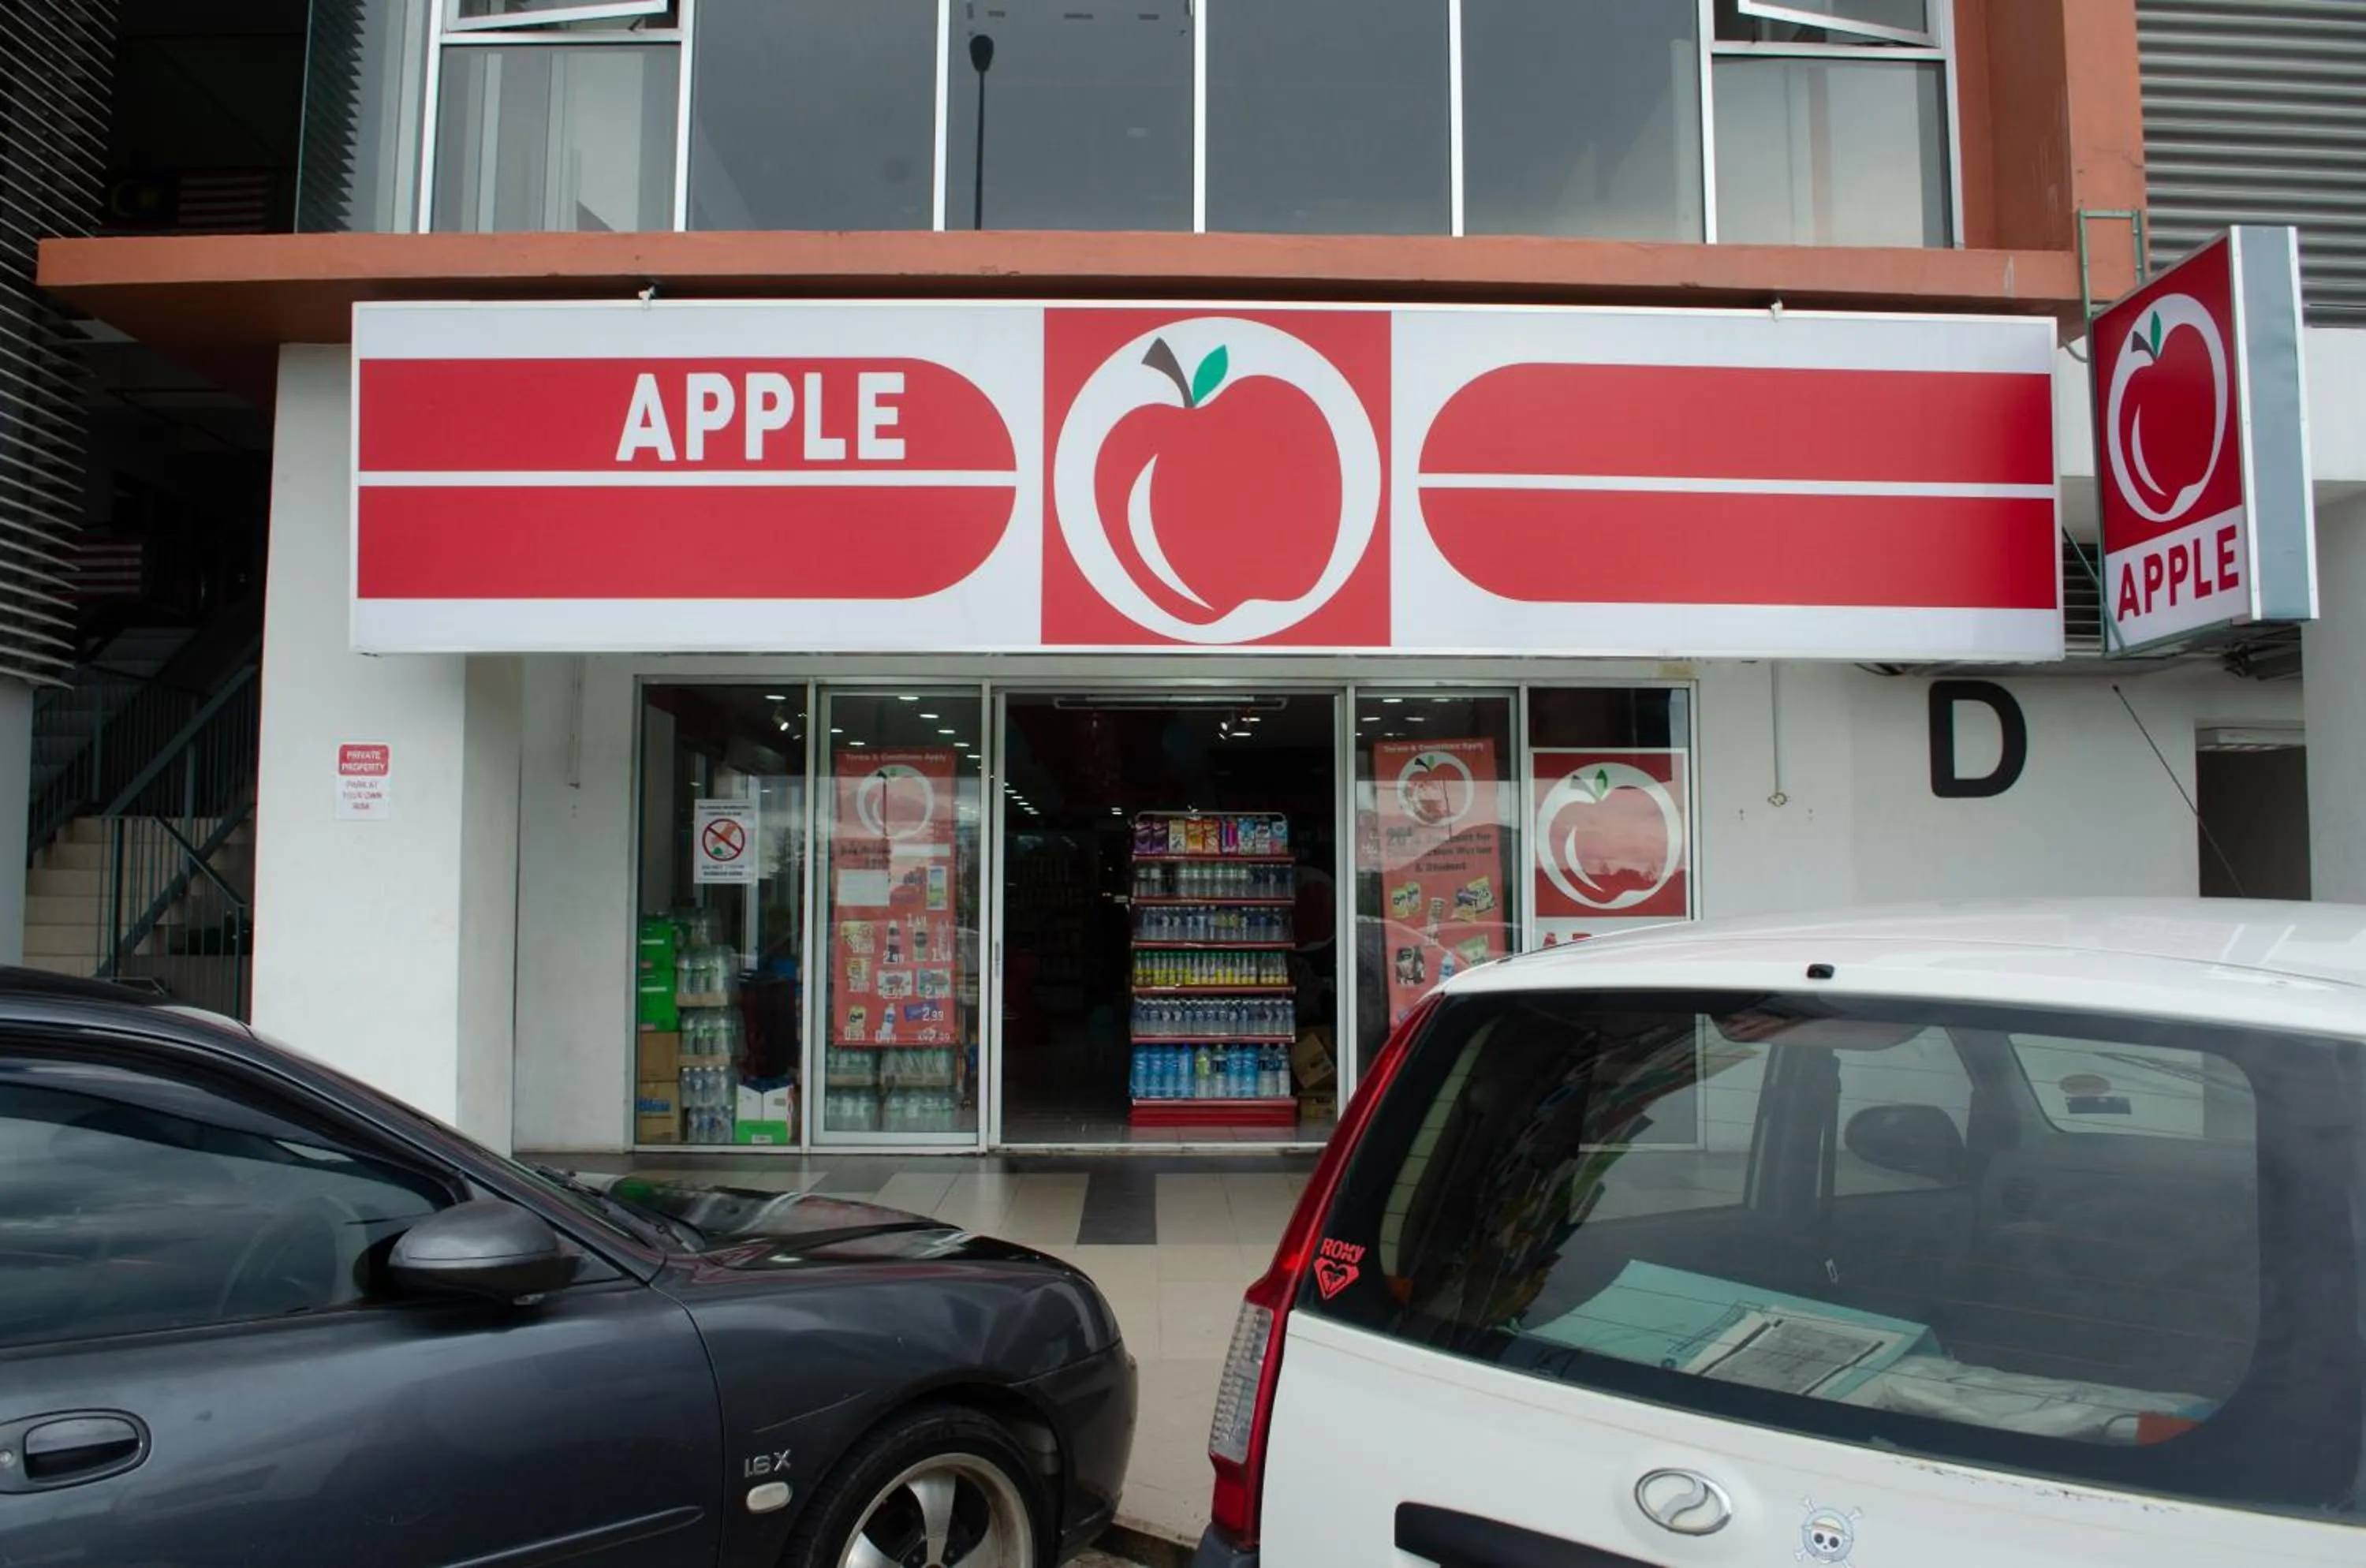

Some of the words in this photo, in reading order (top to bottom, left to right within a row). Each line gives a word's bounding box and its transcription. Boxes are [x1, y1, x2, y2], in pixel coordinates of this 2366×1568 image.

[615, 371, 905, 462] APPLE
[2117, 524, 2240, 623] APPLE
[341, 763, 385, 771] PROPERTY
[346, 751, 381, 760] PRIVATE
[1928, 679, 2028, 799] D
